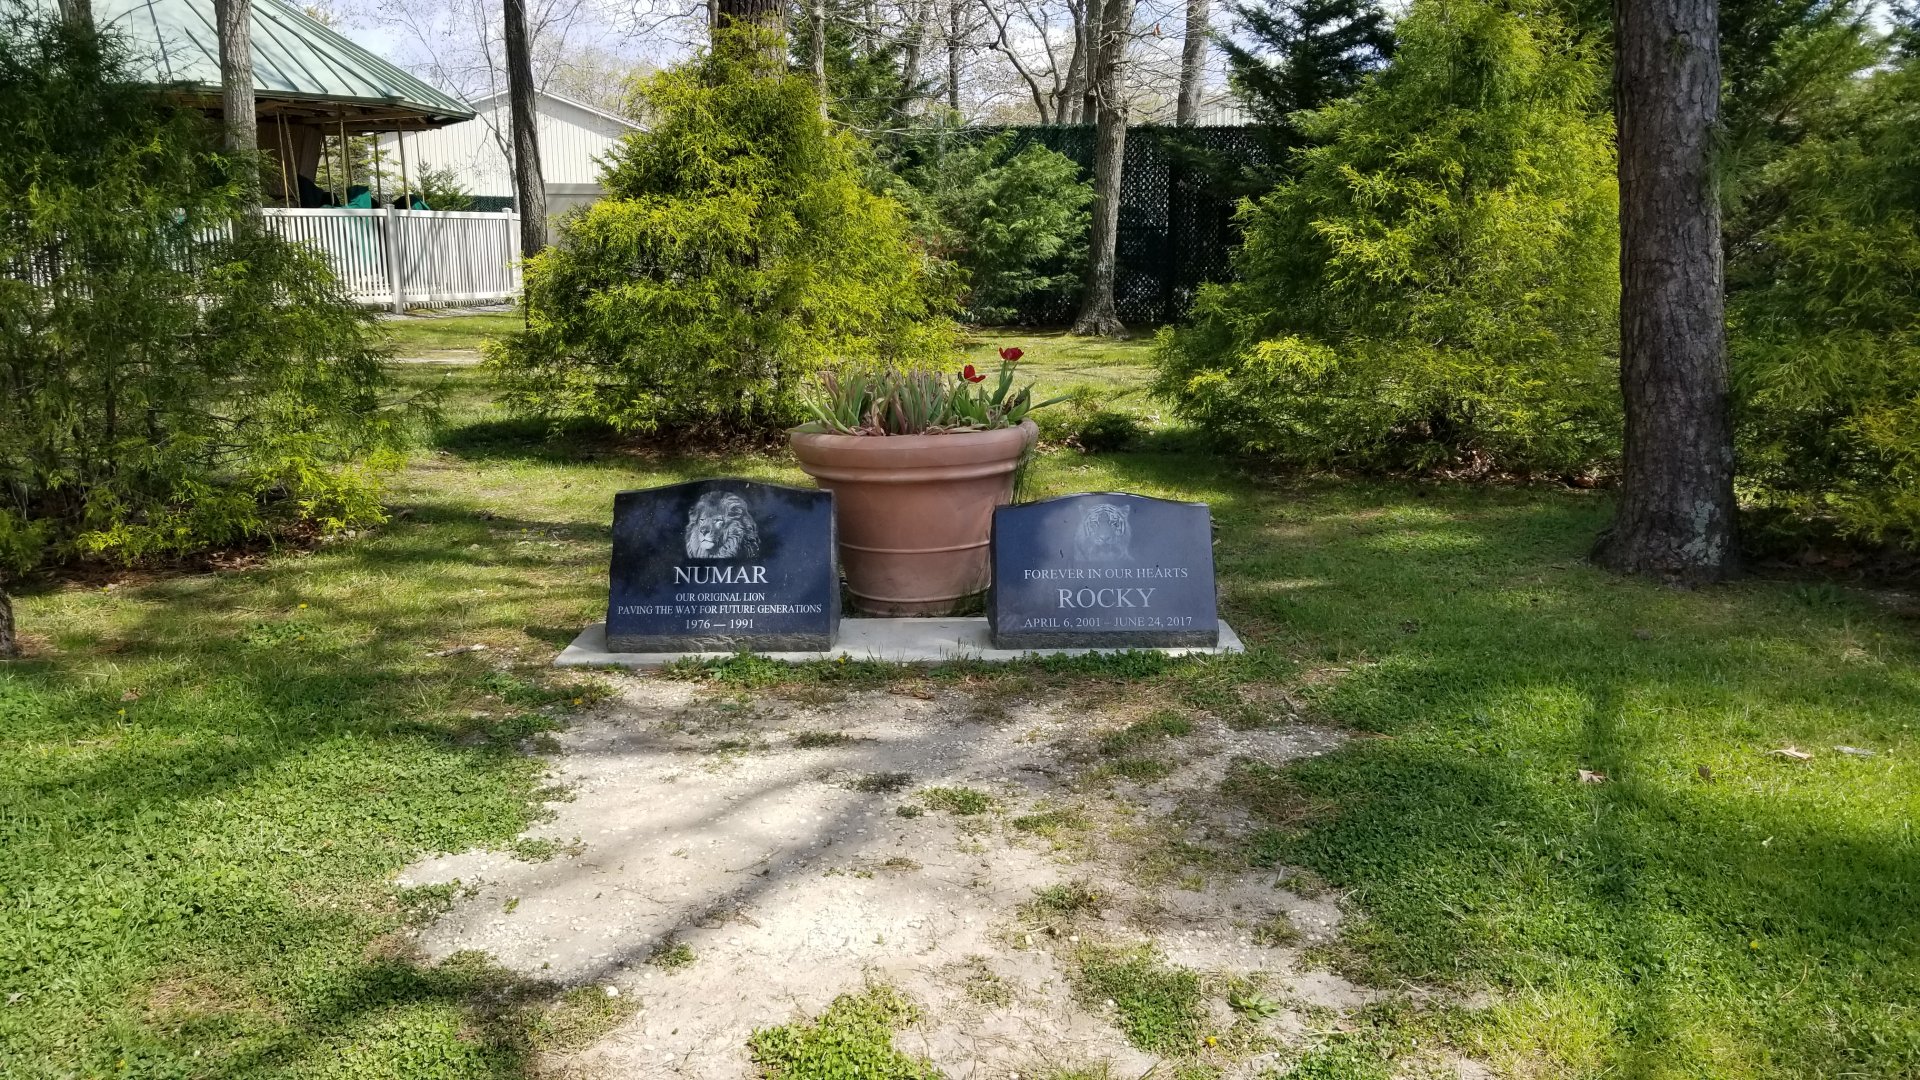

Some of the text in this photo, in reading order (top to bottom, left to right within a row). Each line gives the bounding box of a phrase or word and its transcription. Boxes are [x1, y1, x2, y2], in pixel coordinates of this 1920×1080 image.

[673, 565, 769, 585] NUMAR
[1024, 567, 1188, 580] FOREVER IN OUR HEARTS
[675, 592, 766, 602] OUR ORIGINAL LION
[1056, 587, 1156, 609] ROCKY
[618, 603, 823, 615] PAVING THE WAY FOR FUTURE GENERATIONS
[686, 619, 711, 630] 1976
[730, 618, 754, 629] 1991
[1024, 617, 1061, 628] APRIL
[1063, 617, 1073, 628] 6,
[1076, 616, 1101, 628] 2001
[1113, 616, 1145, 627] JUNE
[1148, 616, 1164, 628] 24,
[1166, 616, 1192, 627] 2017
